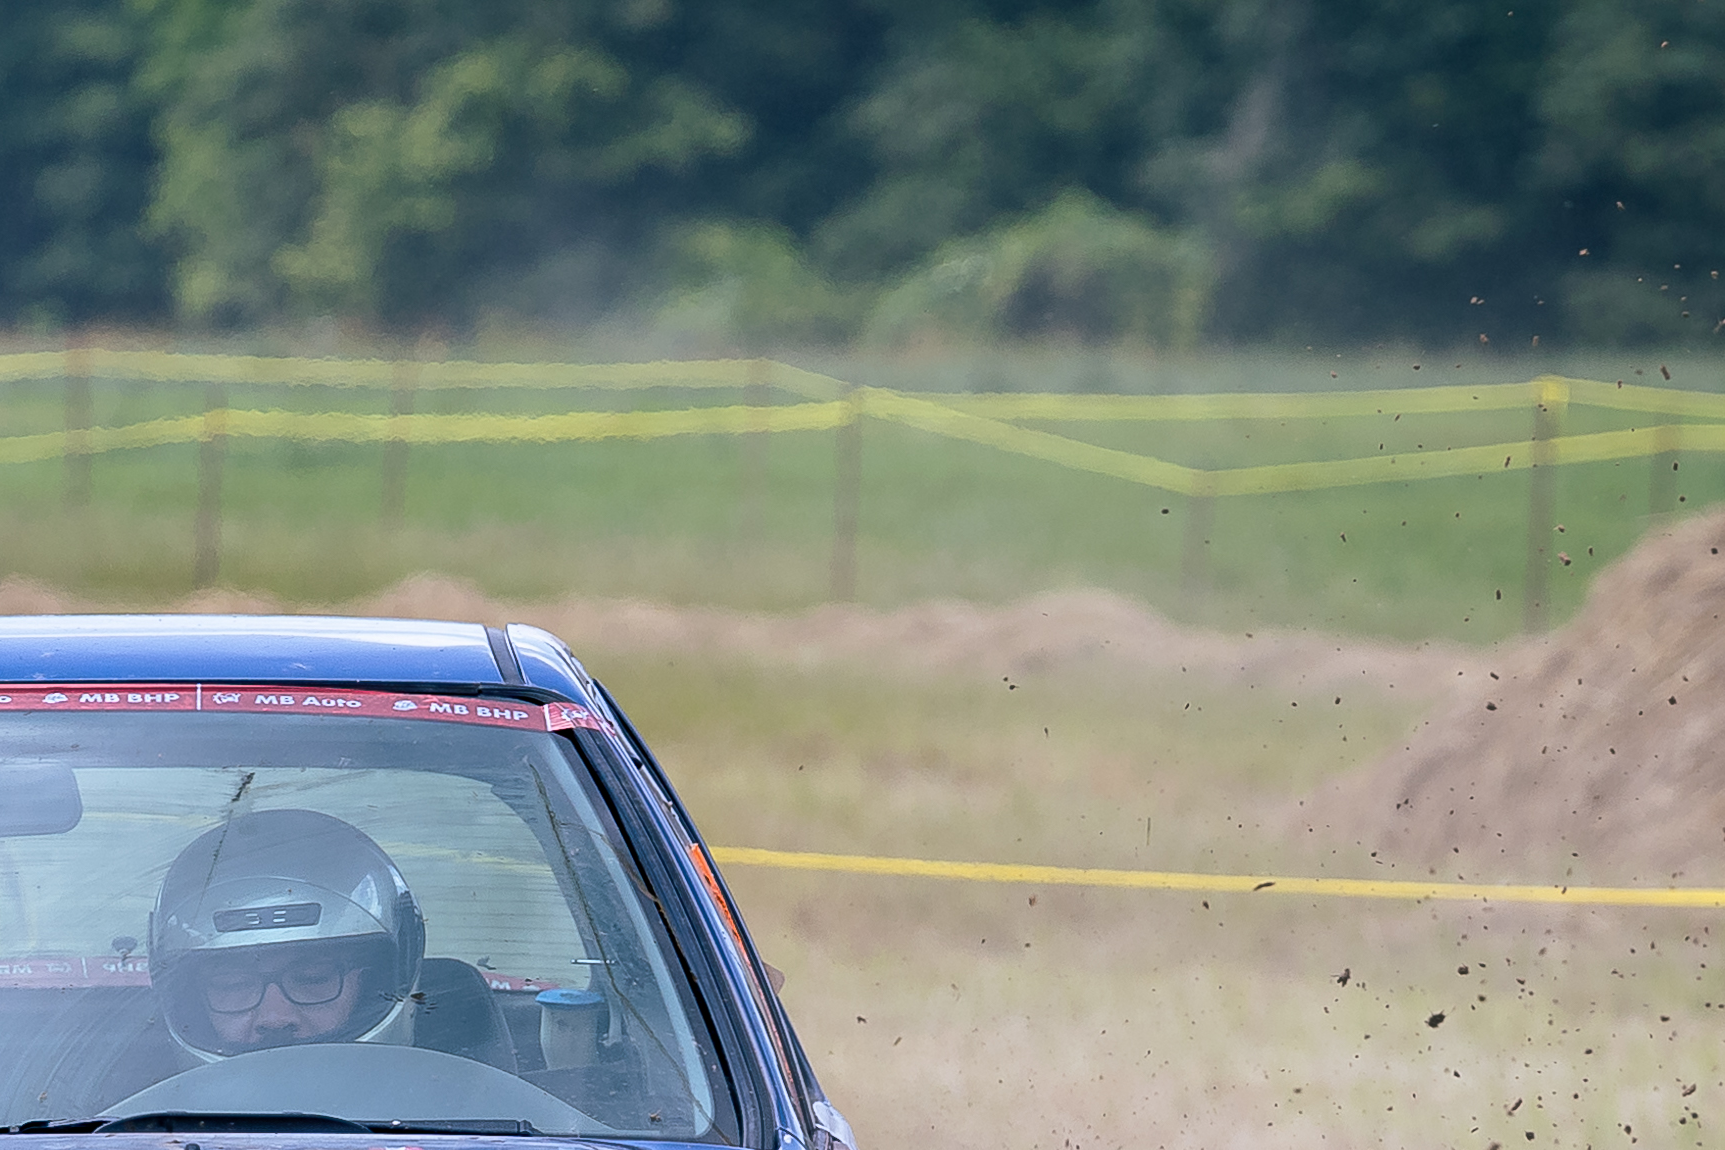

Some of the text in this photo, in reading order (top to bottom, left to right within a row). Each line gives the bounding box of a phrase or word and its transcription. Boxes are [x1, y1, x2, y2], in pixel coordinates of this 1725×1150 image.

[80, 692, 119, 703] MB
[127, 691, 179, 703] BHP
[255, 693, 295, 706] MB
[302, 695, 362, 709] Auto
[429, 702, 469, 716] MB
[476, 705, 529, 721] BHP
